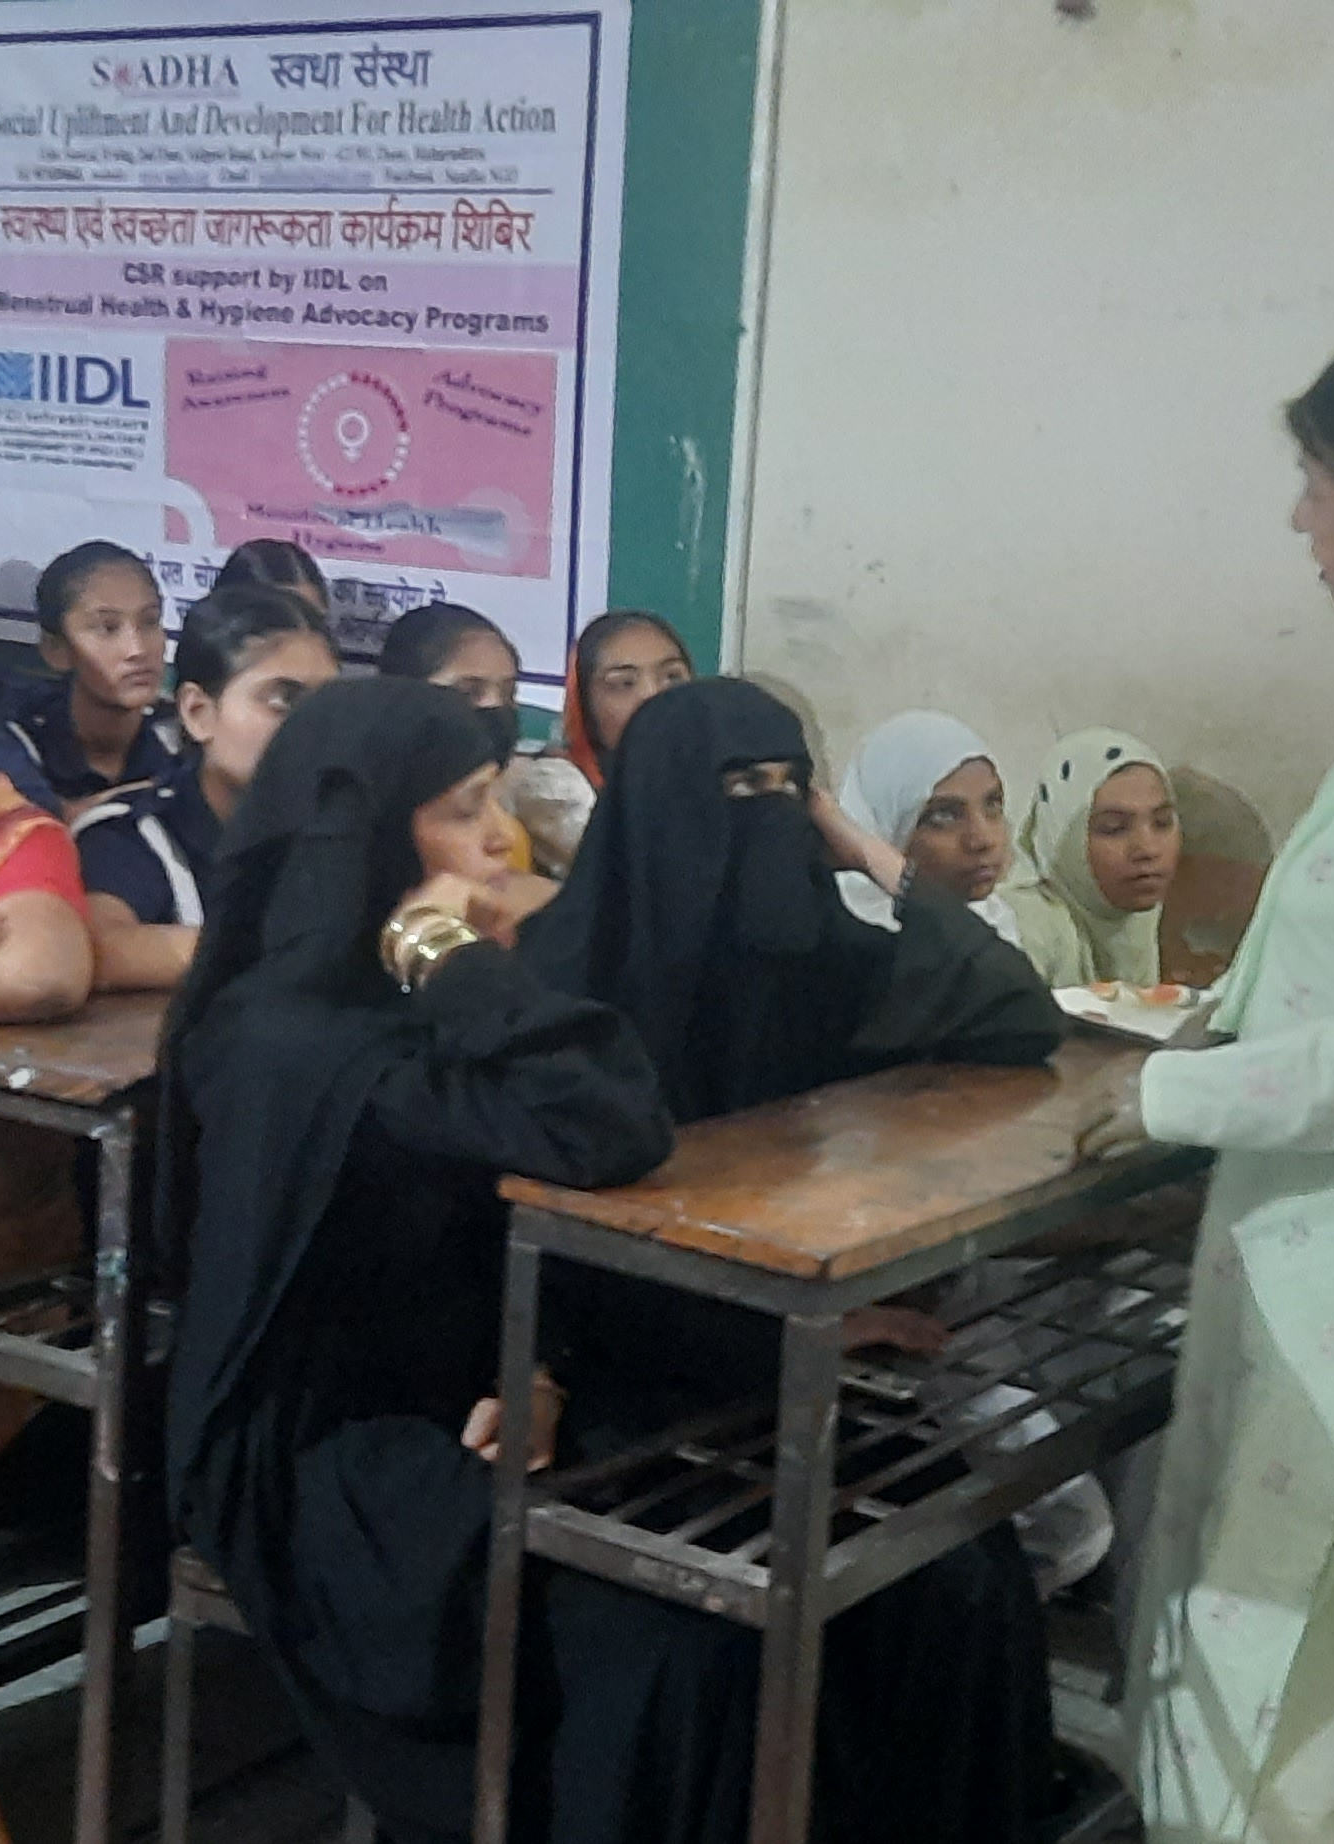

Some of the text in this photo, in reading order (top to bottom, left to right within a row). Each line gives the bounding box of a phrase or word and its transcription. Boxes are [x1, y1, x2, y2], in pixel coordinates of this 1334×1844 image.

[269, 43, 432, 90] स्वधा संस्था
[205, 101, 343, 149] Development
[351, 100, 391, 135] For
[398, 99, 471, 134] Health
[483, 97, 557, 133] Action
[204, 209, 332, 248] जागरूकता
[338, 194, 445, 251] कार्यक्रम
[124, 262, 388, 295] CSR support by IIDL on
[100, 294, 169, 318] Health
[175, 297, 192, 319] &
[201, 298, 294, 326] Hygiene
[302, 302, 417, 333] Advocacy
[425, 306, 549, 336] Programs
[39, 354, 151, 409] IIDL
